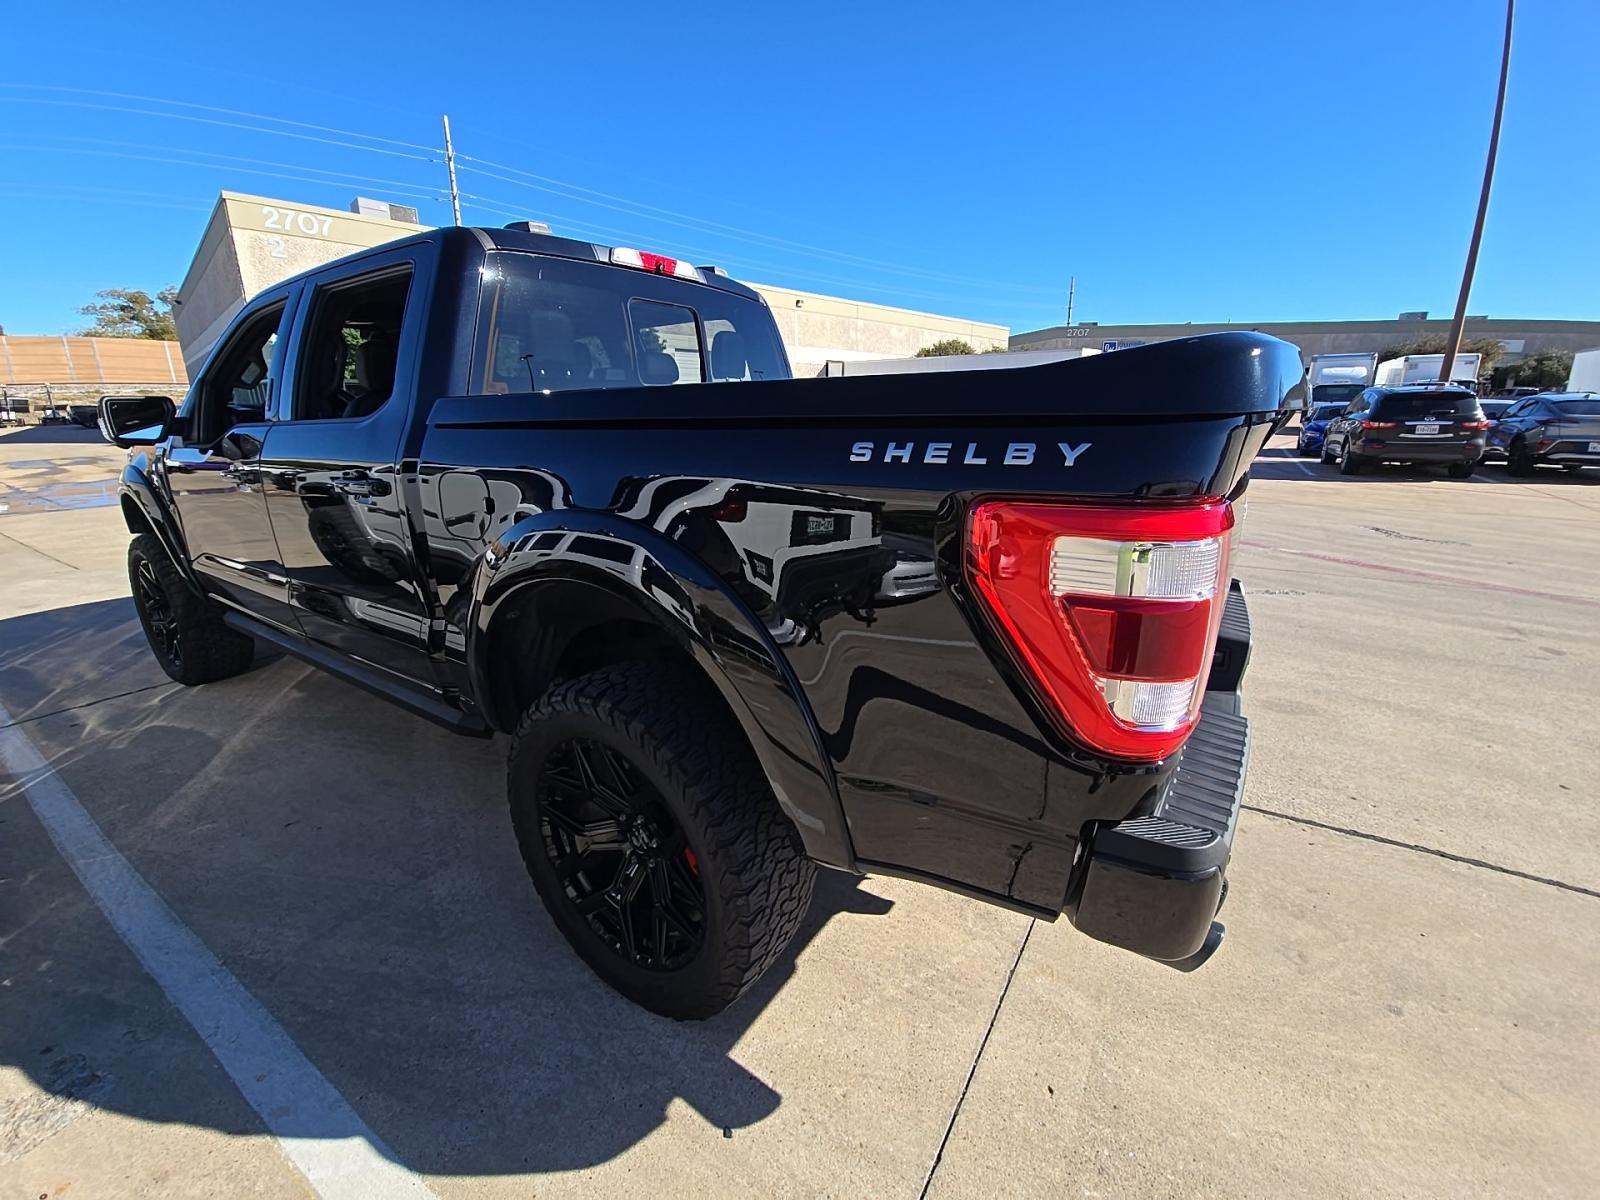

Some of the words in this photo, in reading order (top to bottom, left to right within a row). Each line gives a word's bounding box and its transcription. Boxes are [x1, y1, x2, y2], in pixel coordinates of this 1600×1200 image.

[262, 206, 333, 236] 2707
[267, 236, 288, 258] 2
[1066, 328, 1090, 337] 2707
[849, 442, 1092, 466] SHELBY
